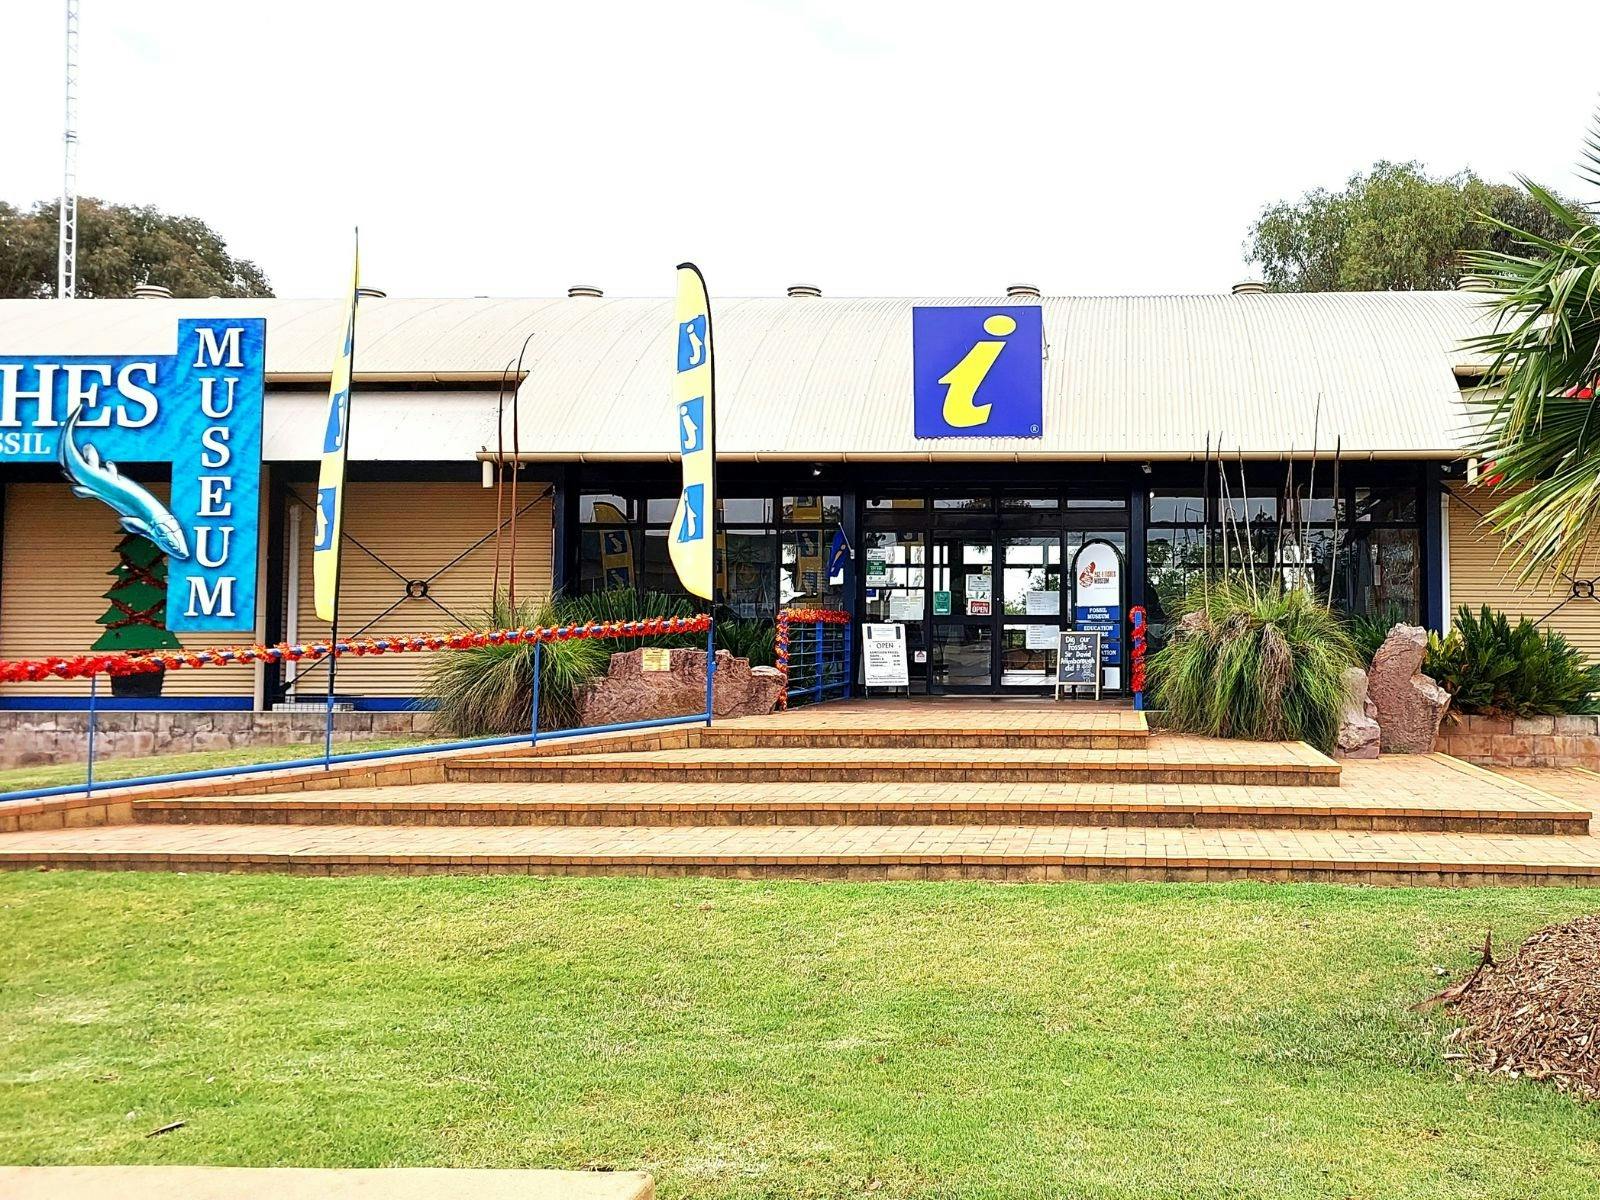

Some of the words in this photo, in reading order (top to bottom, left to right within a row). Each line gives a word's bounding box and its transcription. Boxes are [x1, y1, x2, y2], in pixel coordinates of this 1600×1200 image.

[0, 432, 51, 454] SIL
[184, 327, 245, 618] MUSEUM
[1065, 636, 1075, 645] Dig
